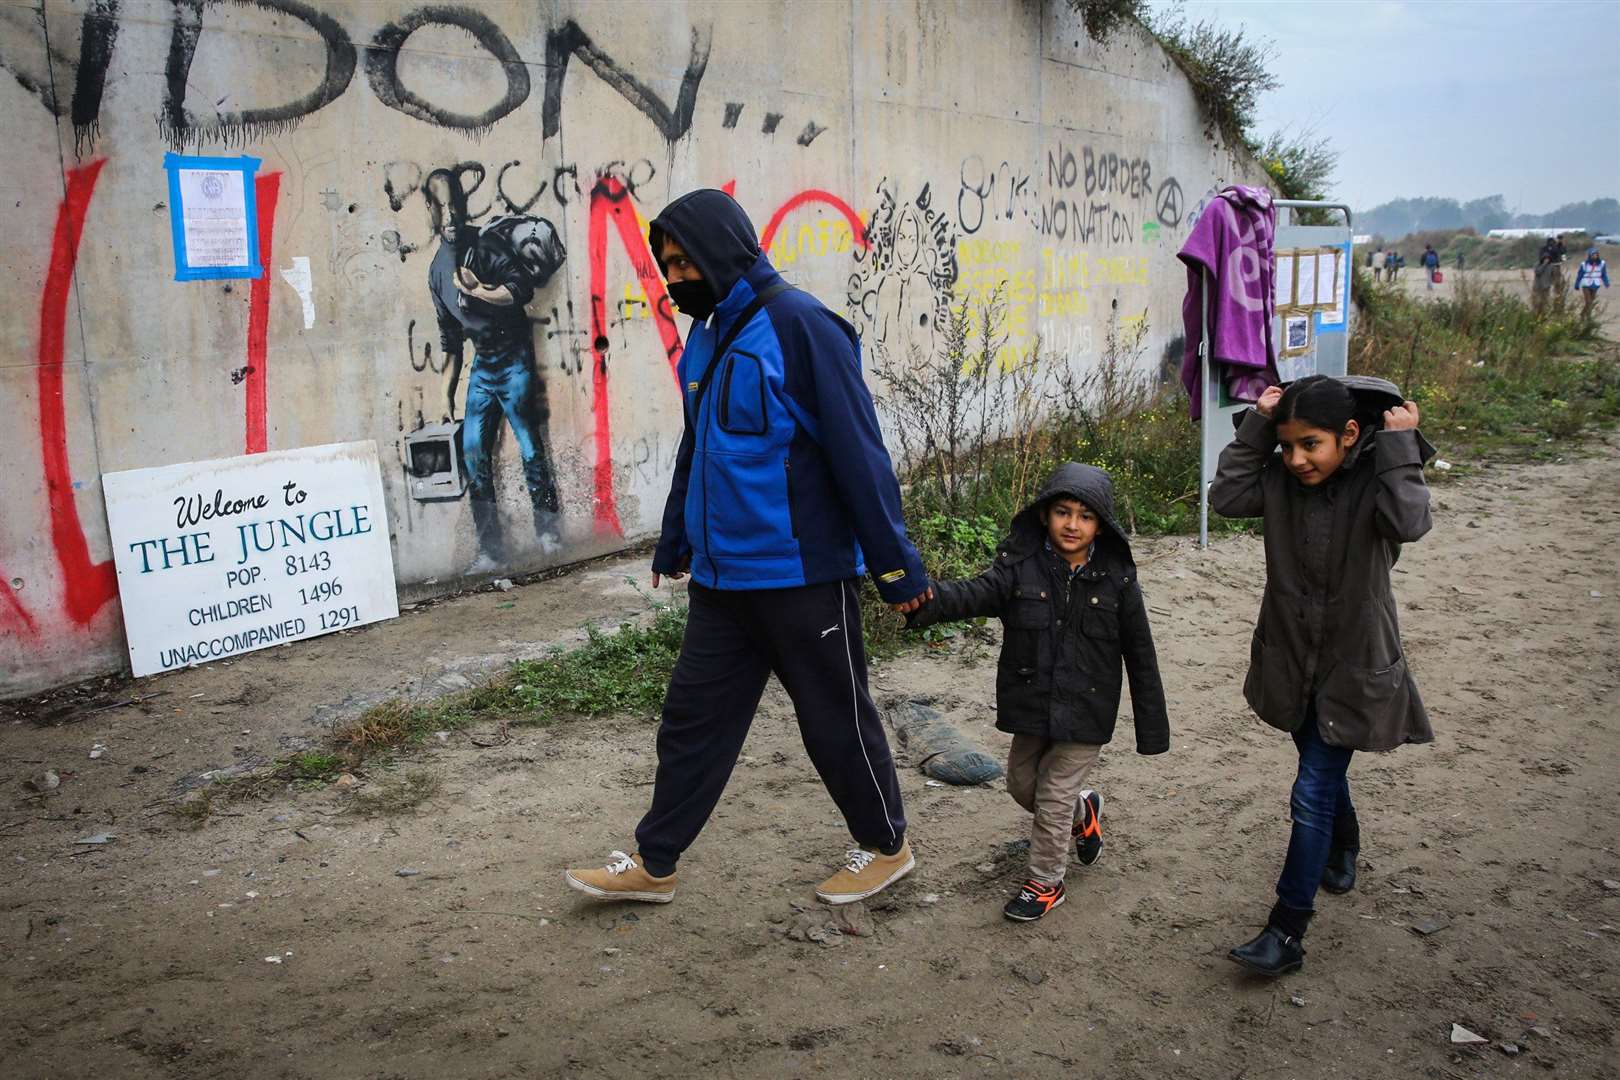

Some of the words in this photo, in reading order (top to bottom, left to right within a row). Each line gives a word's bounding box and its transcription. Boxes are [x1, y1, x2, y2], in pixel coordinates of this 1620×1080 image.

[1049, 141, 1078, 189] NO
[1083, 145, 1153, 198] BORDER
[1041, 199, 1068, 239] NO
[173, 489, 269, 528] Welcome
[282, 480, 307, 506] to
[130, 532, 215, 573] THE
[236, 505, 372, 564] JUNGLE
[226, 566, 267, 588] POP.
[285, 551, 332, 576] 8143
[188, 593, 272, 627] CHILDREN
[298, 577, 343, 606] 1496
[160, 618, 306, 668] UNACCOMPANIED
[319, 605, 360, 631] 1291
